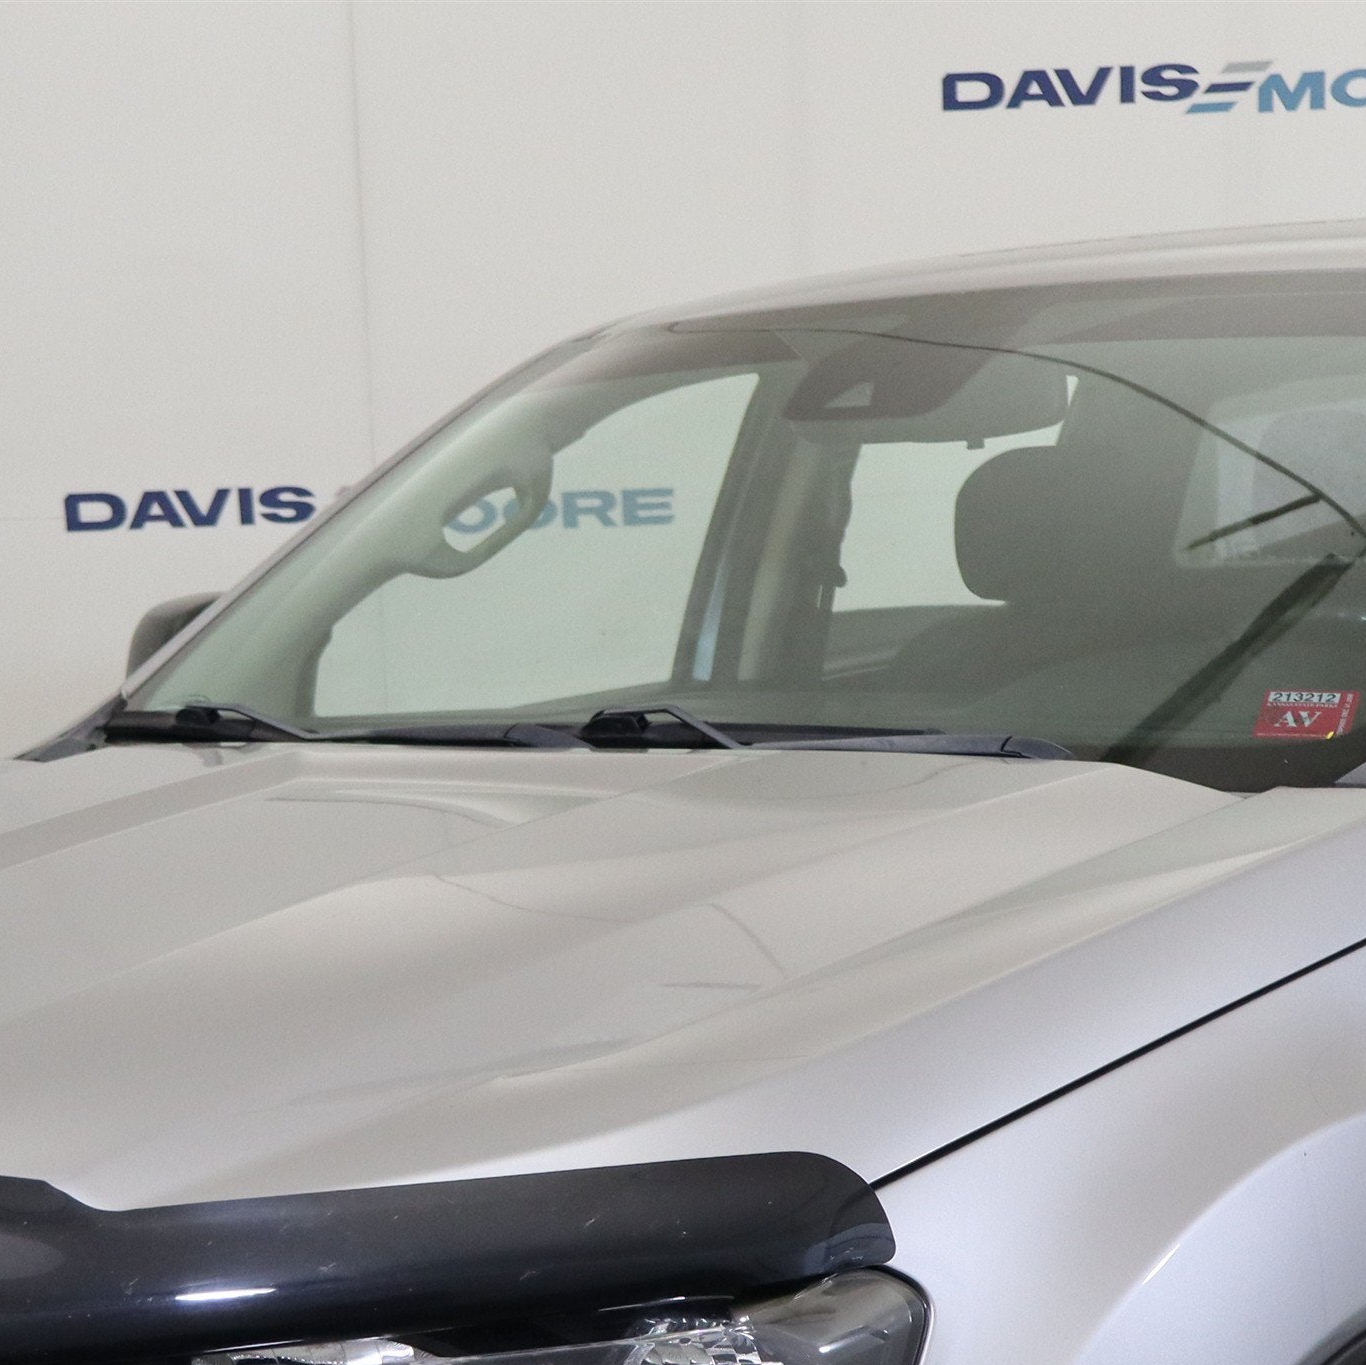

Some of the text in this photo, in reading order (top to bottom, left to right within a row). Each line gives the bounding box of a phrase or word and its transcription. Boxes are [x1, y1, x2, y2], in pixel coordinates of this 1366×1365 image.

[941, 63, 1200, 112] DAVIS
[63, 486, 316, 533] DAVIS
[1273, 710, 1322, 728] AV
